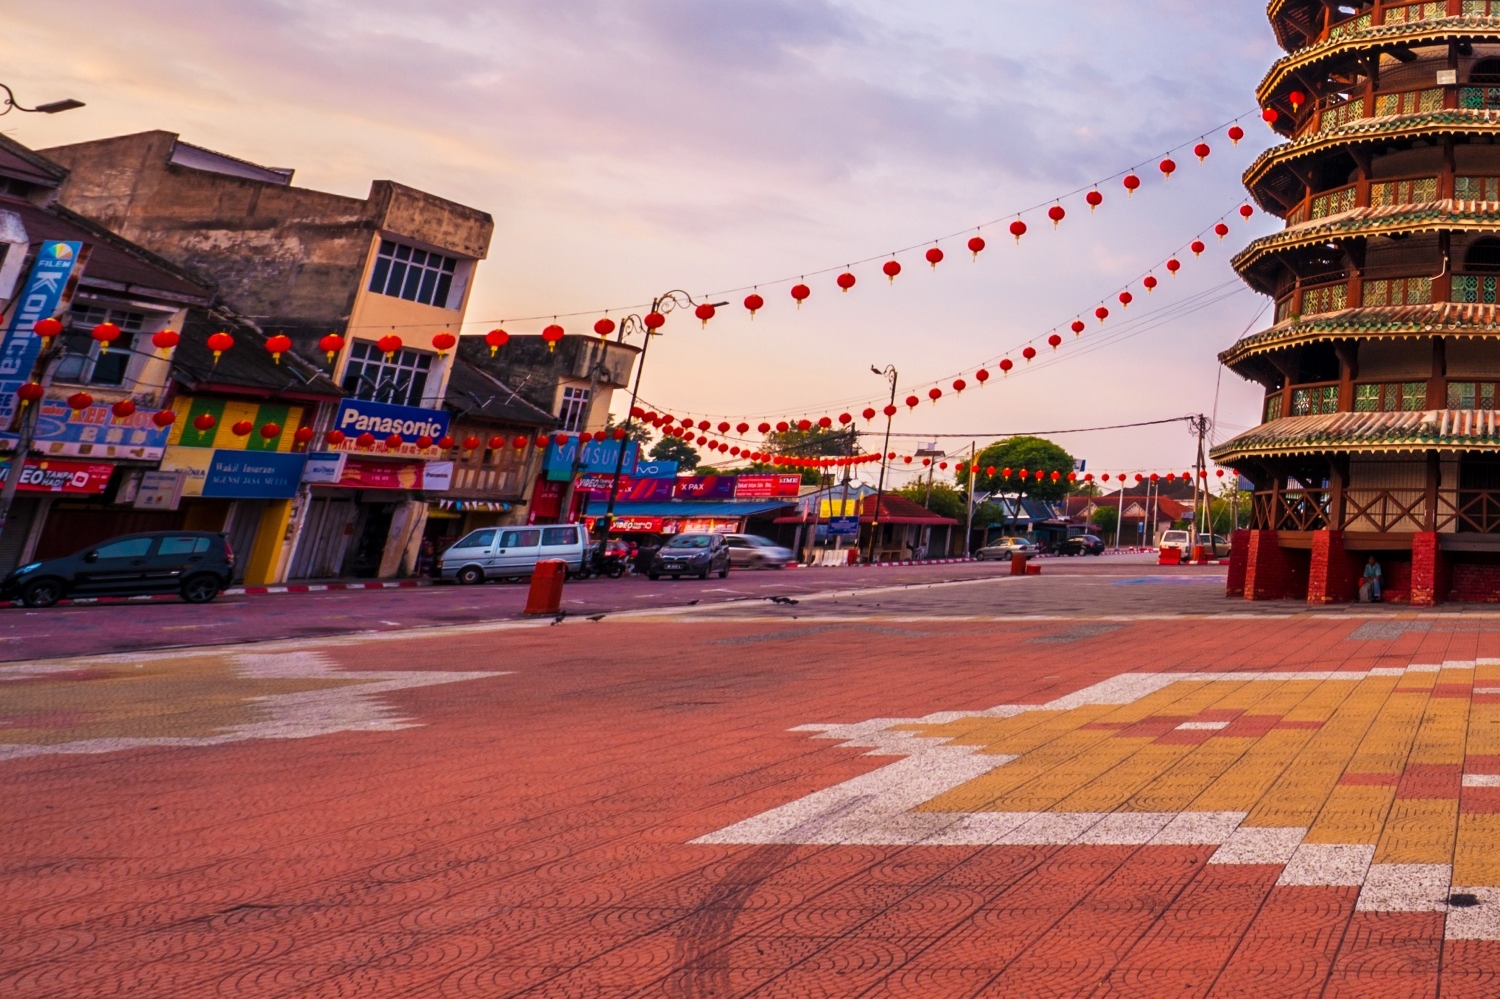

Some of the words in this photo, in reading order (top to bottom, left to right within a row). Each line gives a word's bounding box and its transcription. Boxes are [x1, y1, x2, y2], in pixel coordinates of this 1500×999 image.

[38, 259, 71, 268] FILEM
[0, 271, 63, 375] Konica
[69, 406, 108, 425] KEE
[341, 408, 442, 438] Panasonic
[556, 446, 631, 466] SAMSUNG
[0, 465, 44, 485] VIEO
[46, 469, 75, 481] TANPA
[216, 462, 240, 473] Wakil
[243, 463, 275, 474] Insurans
[636, 465, 659, 474] ivo
[681, 483, 689, 491] X
[688, 483, 705, 491] PAX
[612, 520, 633, 530] VIDEO
